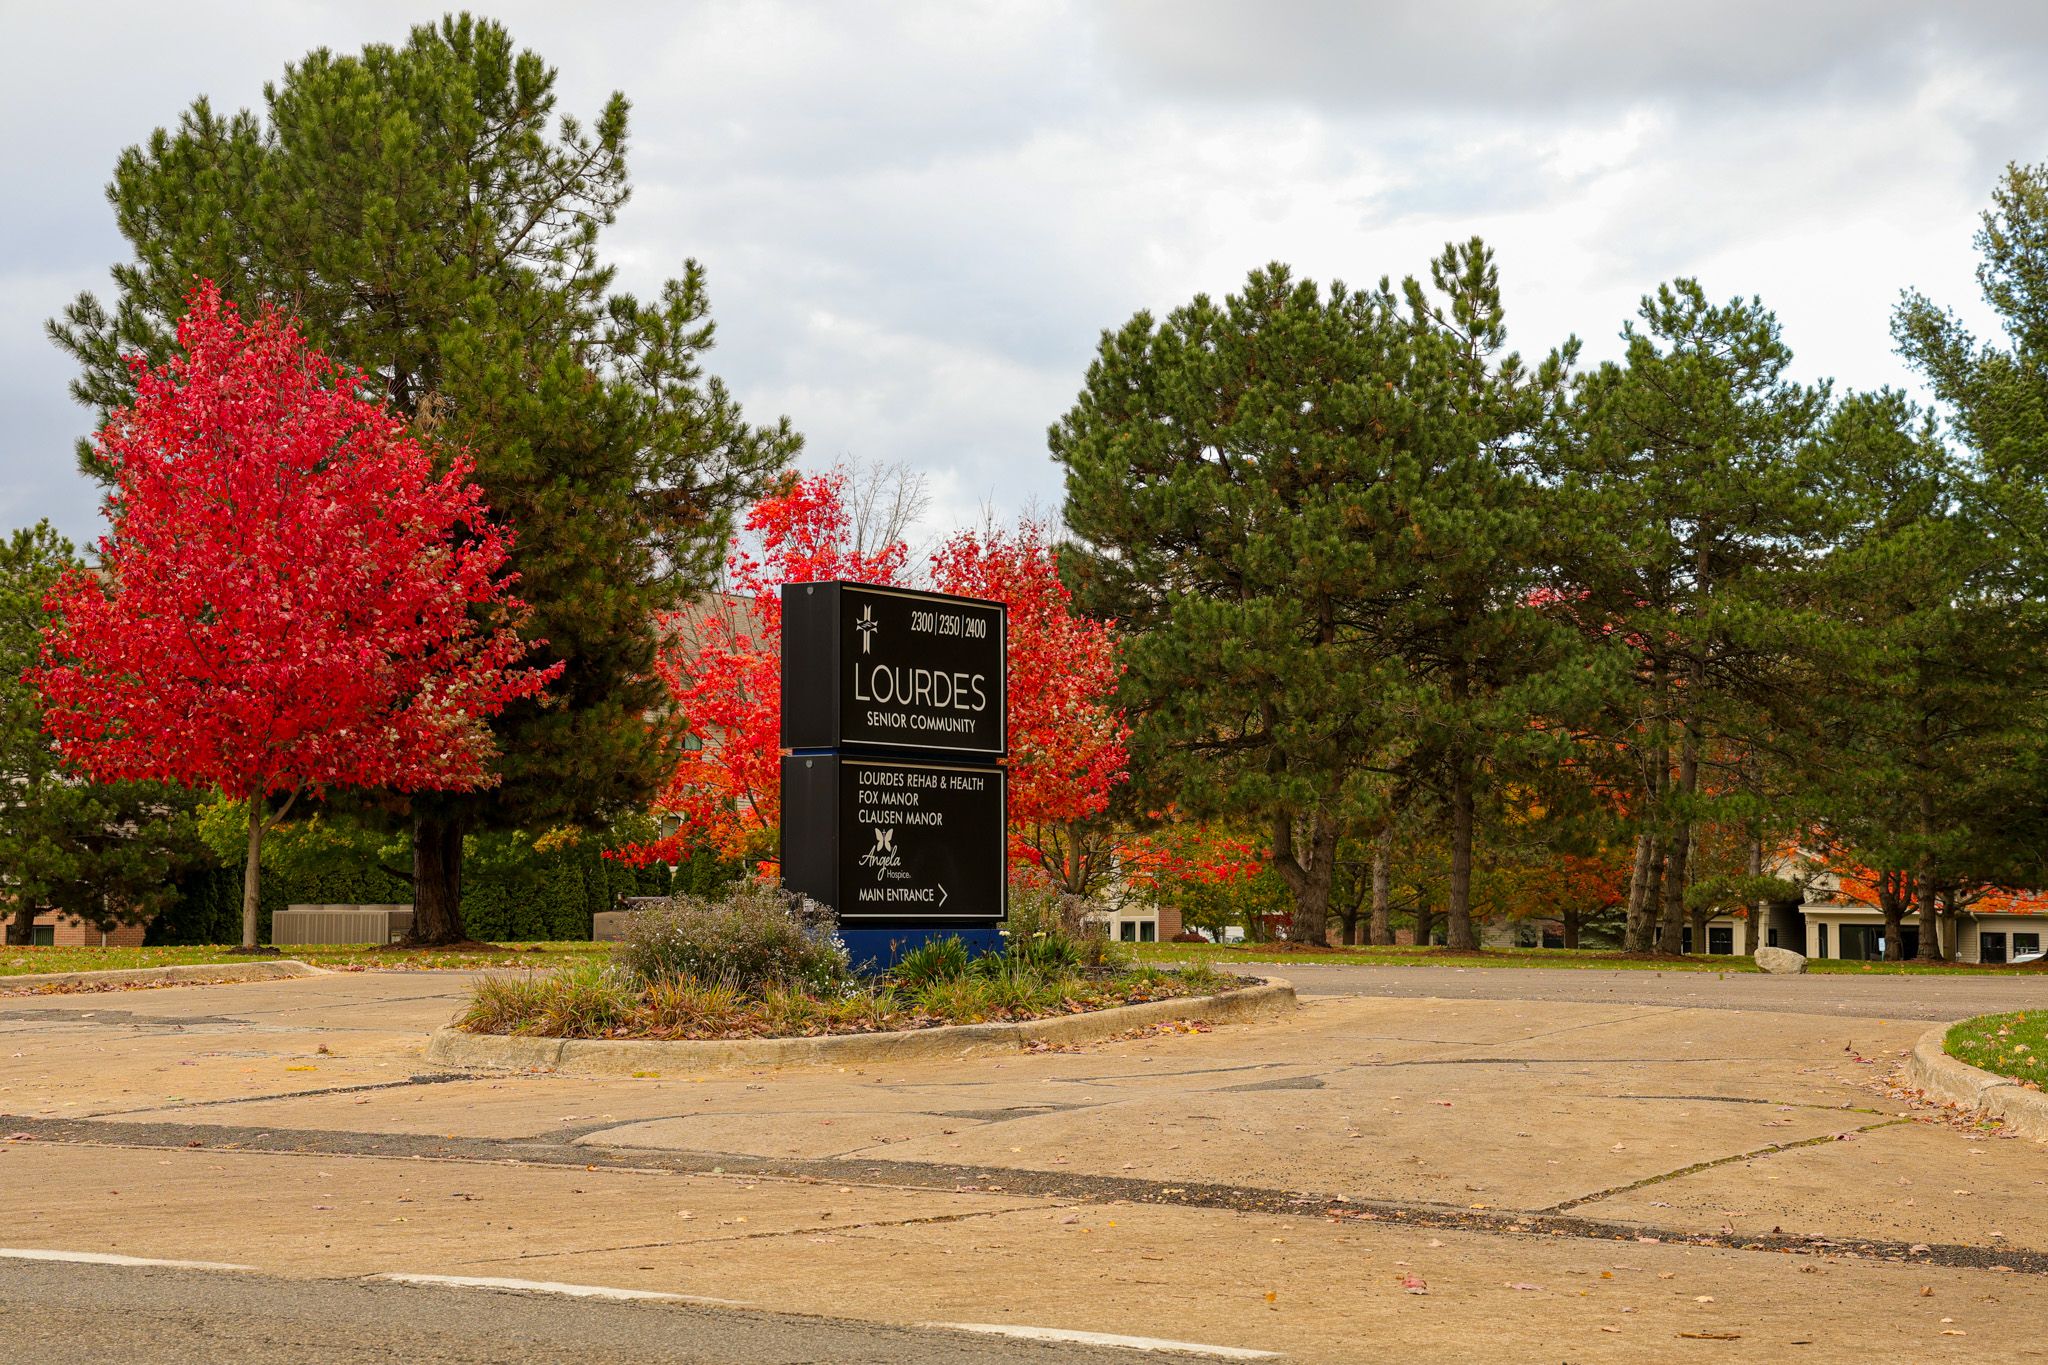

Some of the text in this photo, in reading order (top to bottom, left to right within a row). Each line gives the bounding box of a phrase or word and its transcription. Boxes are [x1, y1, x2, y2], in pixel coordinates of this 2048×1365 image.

[855, 662, 986, 711] LOURDES
[866, 711, 976, 734] SENIOR COMMUNITY
[859, 771, 984, 791] LOURDES REHAB & HEALTH
[858, 790, 919, 807] FOX MANOR
[858, 809, 943, 826] CLAUSEN MANOR
[859, 844, 902, 882] Angela
[886, 869, 910, 881] Hospice
[858, 888, 935, 902] MAIN ENTRANCE
